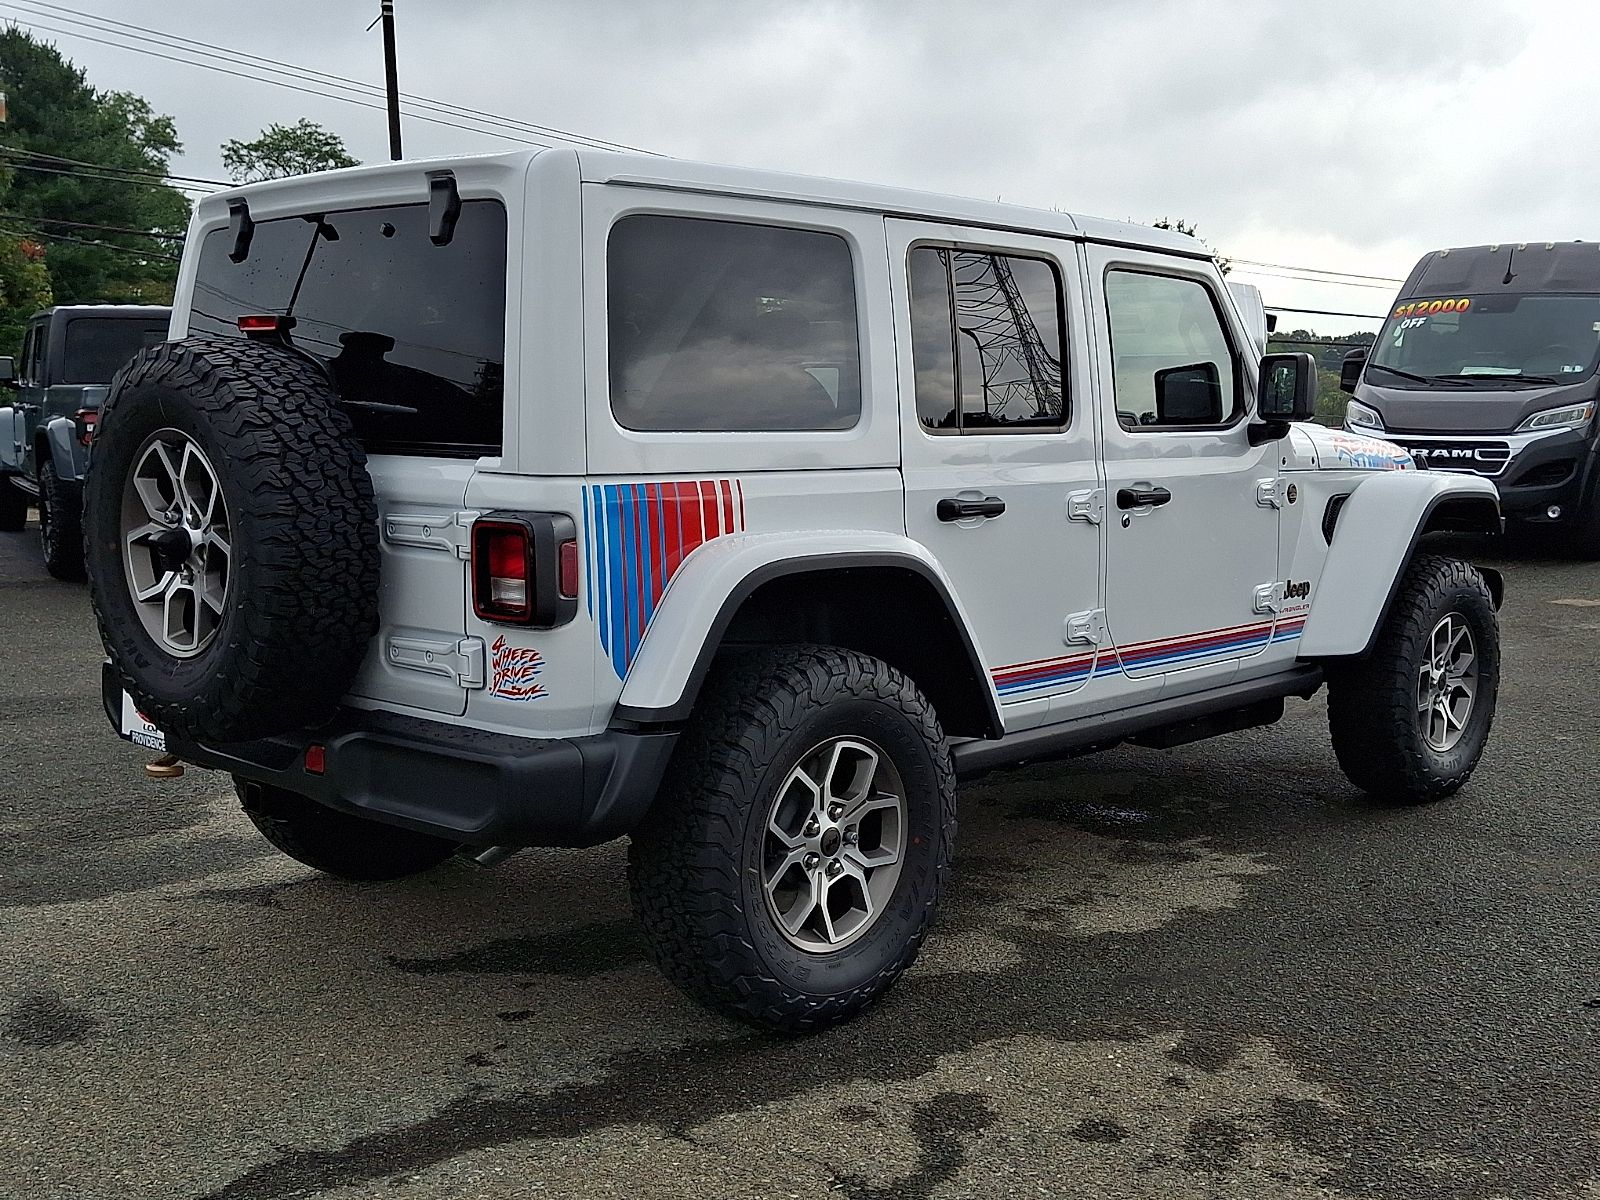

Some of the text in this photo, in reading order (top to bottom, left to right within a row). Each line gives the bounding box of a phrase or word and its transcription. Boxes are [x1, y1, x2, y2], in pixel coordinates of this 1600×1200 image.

[1400, 316, 1427, 329] OFF
[1410, 448, 1472, 458] RAM
[1283, 579, 1310, 600] Jeep
[1279, 603, 1310, 614] WRANGLER
[491, 634, 507, 655] 4
[492, 647, 543, 670] WHEEL
[492, 666, 538, 692] DRIVE
[131, 731, 167, 752] PROVIDENCE
